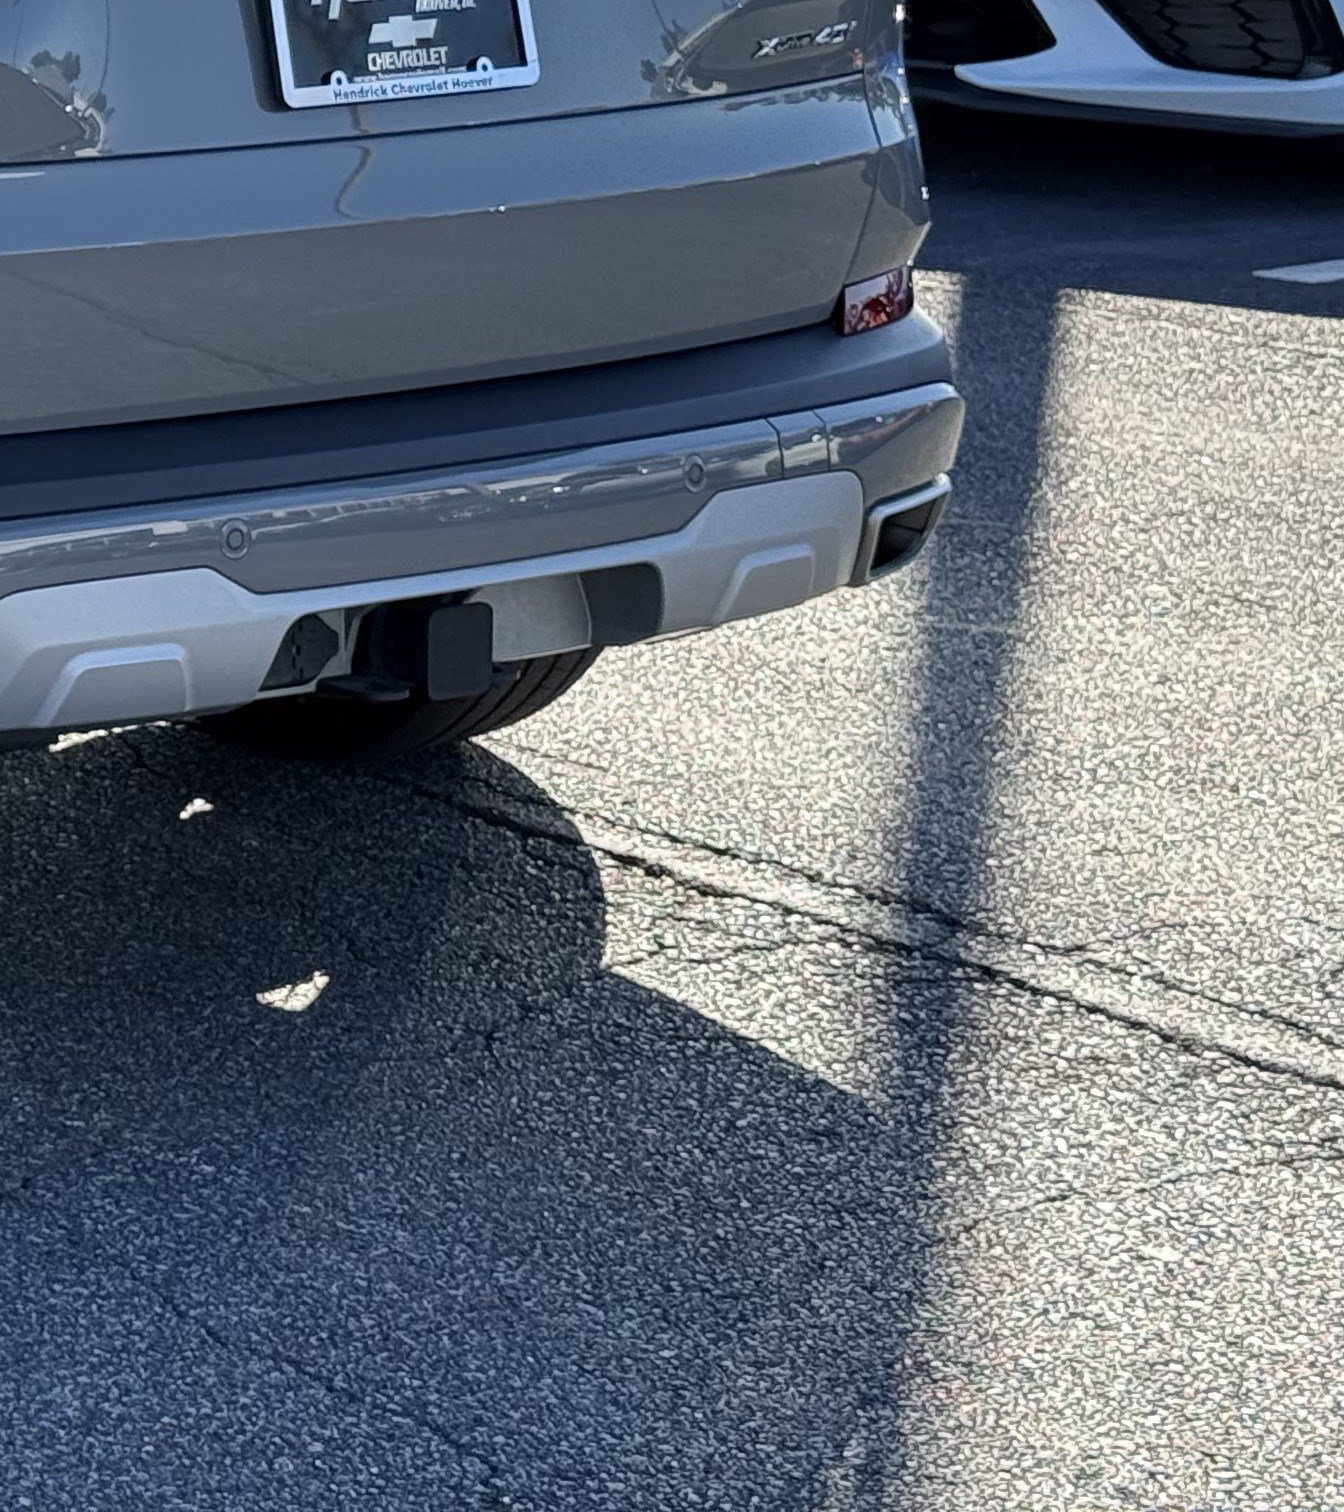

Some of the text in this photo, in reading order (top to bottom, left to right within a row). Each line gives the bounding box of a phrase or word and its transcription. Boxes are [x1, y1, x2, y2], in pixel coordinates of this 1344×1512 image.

[367, 45, 450, 72] CHEVROLET
[333, 83, 389, 102] Hendrick
[391, 78, 449, 97] Chevrolet
